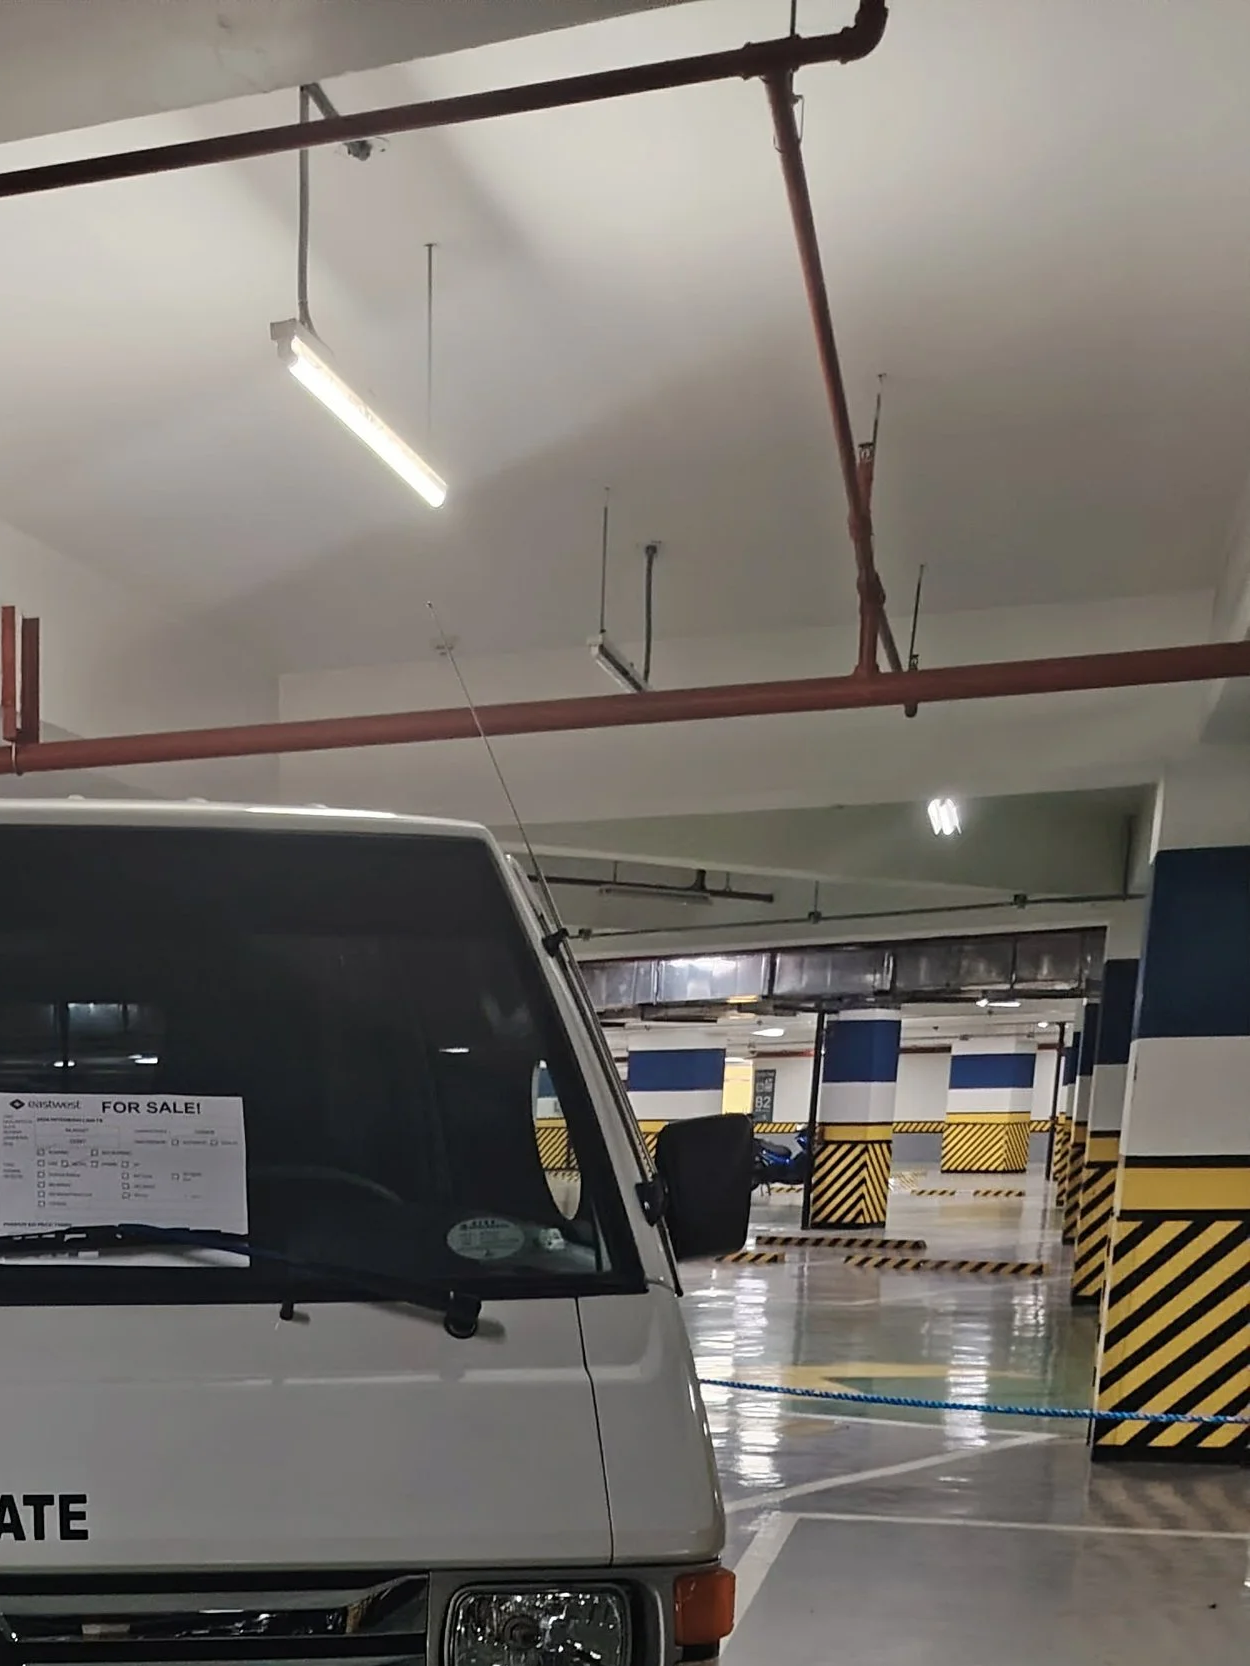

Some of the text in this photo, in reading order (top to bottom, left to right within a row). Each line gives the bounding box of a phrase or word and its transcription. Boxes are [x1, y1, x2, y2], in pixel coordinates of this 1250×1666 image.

[27, 1099, 81, 1110] eastwest
[101, 1101, 201, 1115] FOR SALE!
[755, 1096, 771, 1109] B2
